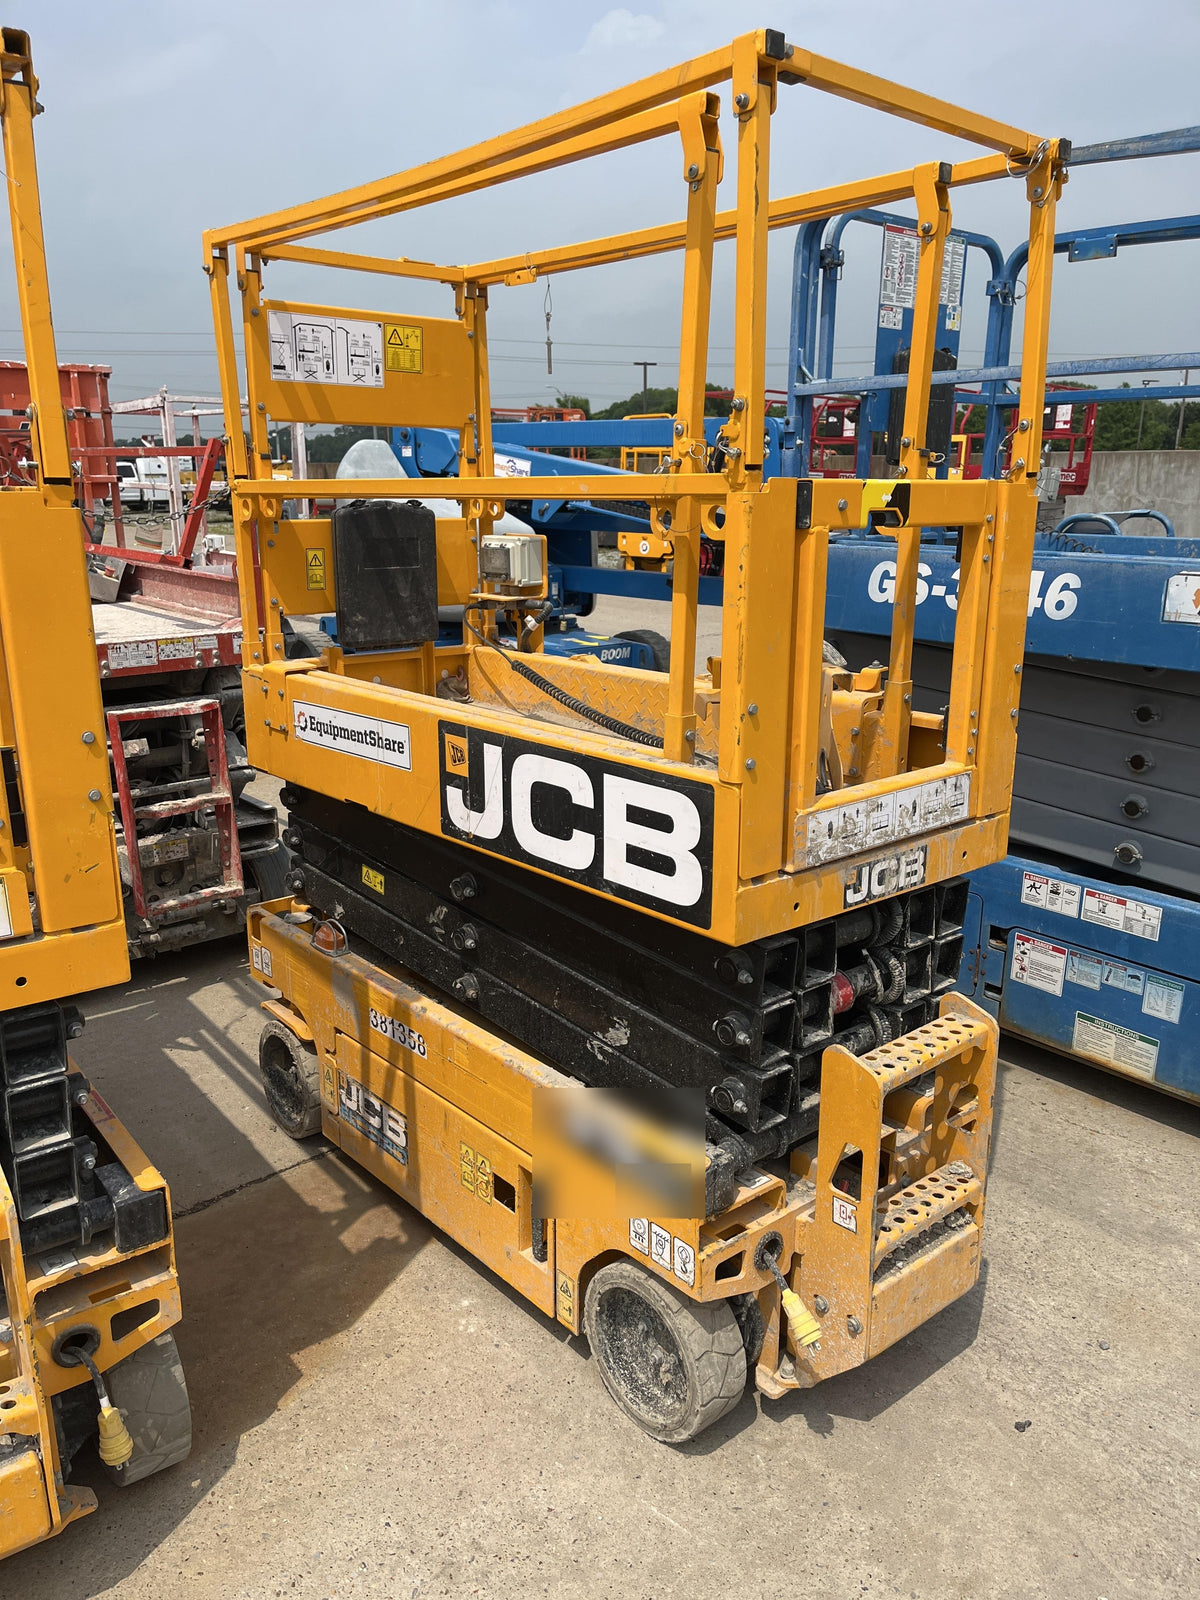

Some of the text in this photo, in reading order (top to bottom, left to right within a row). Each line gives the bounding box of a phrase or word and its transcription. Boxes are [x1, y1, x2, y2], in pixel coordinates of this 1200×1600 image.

[601, 647, 631, 660] BOOM
[309, 715, 405, 755] EquipmentShare
[451, 745, 464, 763] JCB
[446, 743, 703, 907] JCB
[846, 850, 926, 904] JCB
[1030, 875, 1047, 884] DANGER
[1100, 893, 1118, 903] DANGER
[1034, 940, 1052, 950] DANGER
[371, 1008, 426, 1056] 381358
[1094, 1019, 1140, 1040] INSTRUCTIONS
[340, 1084, 408, 1148] JCB
